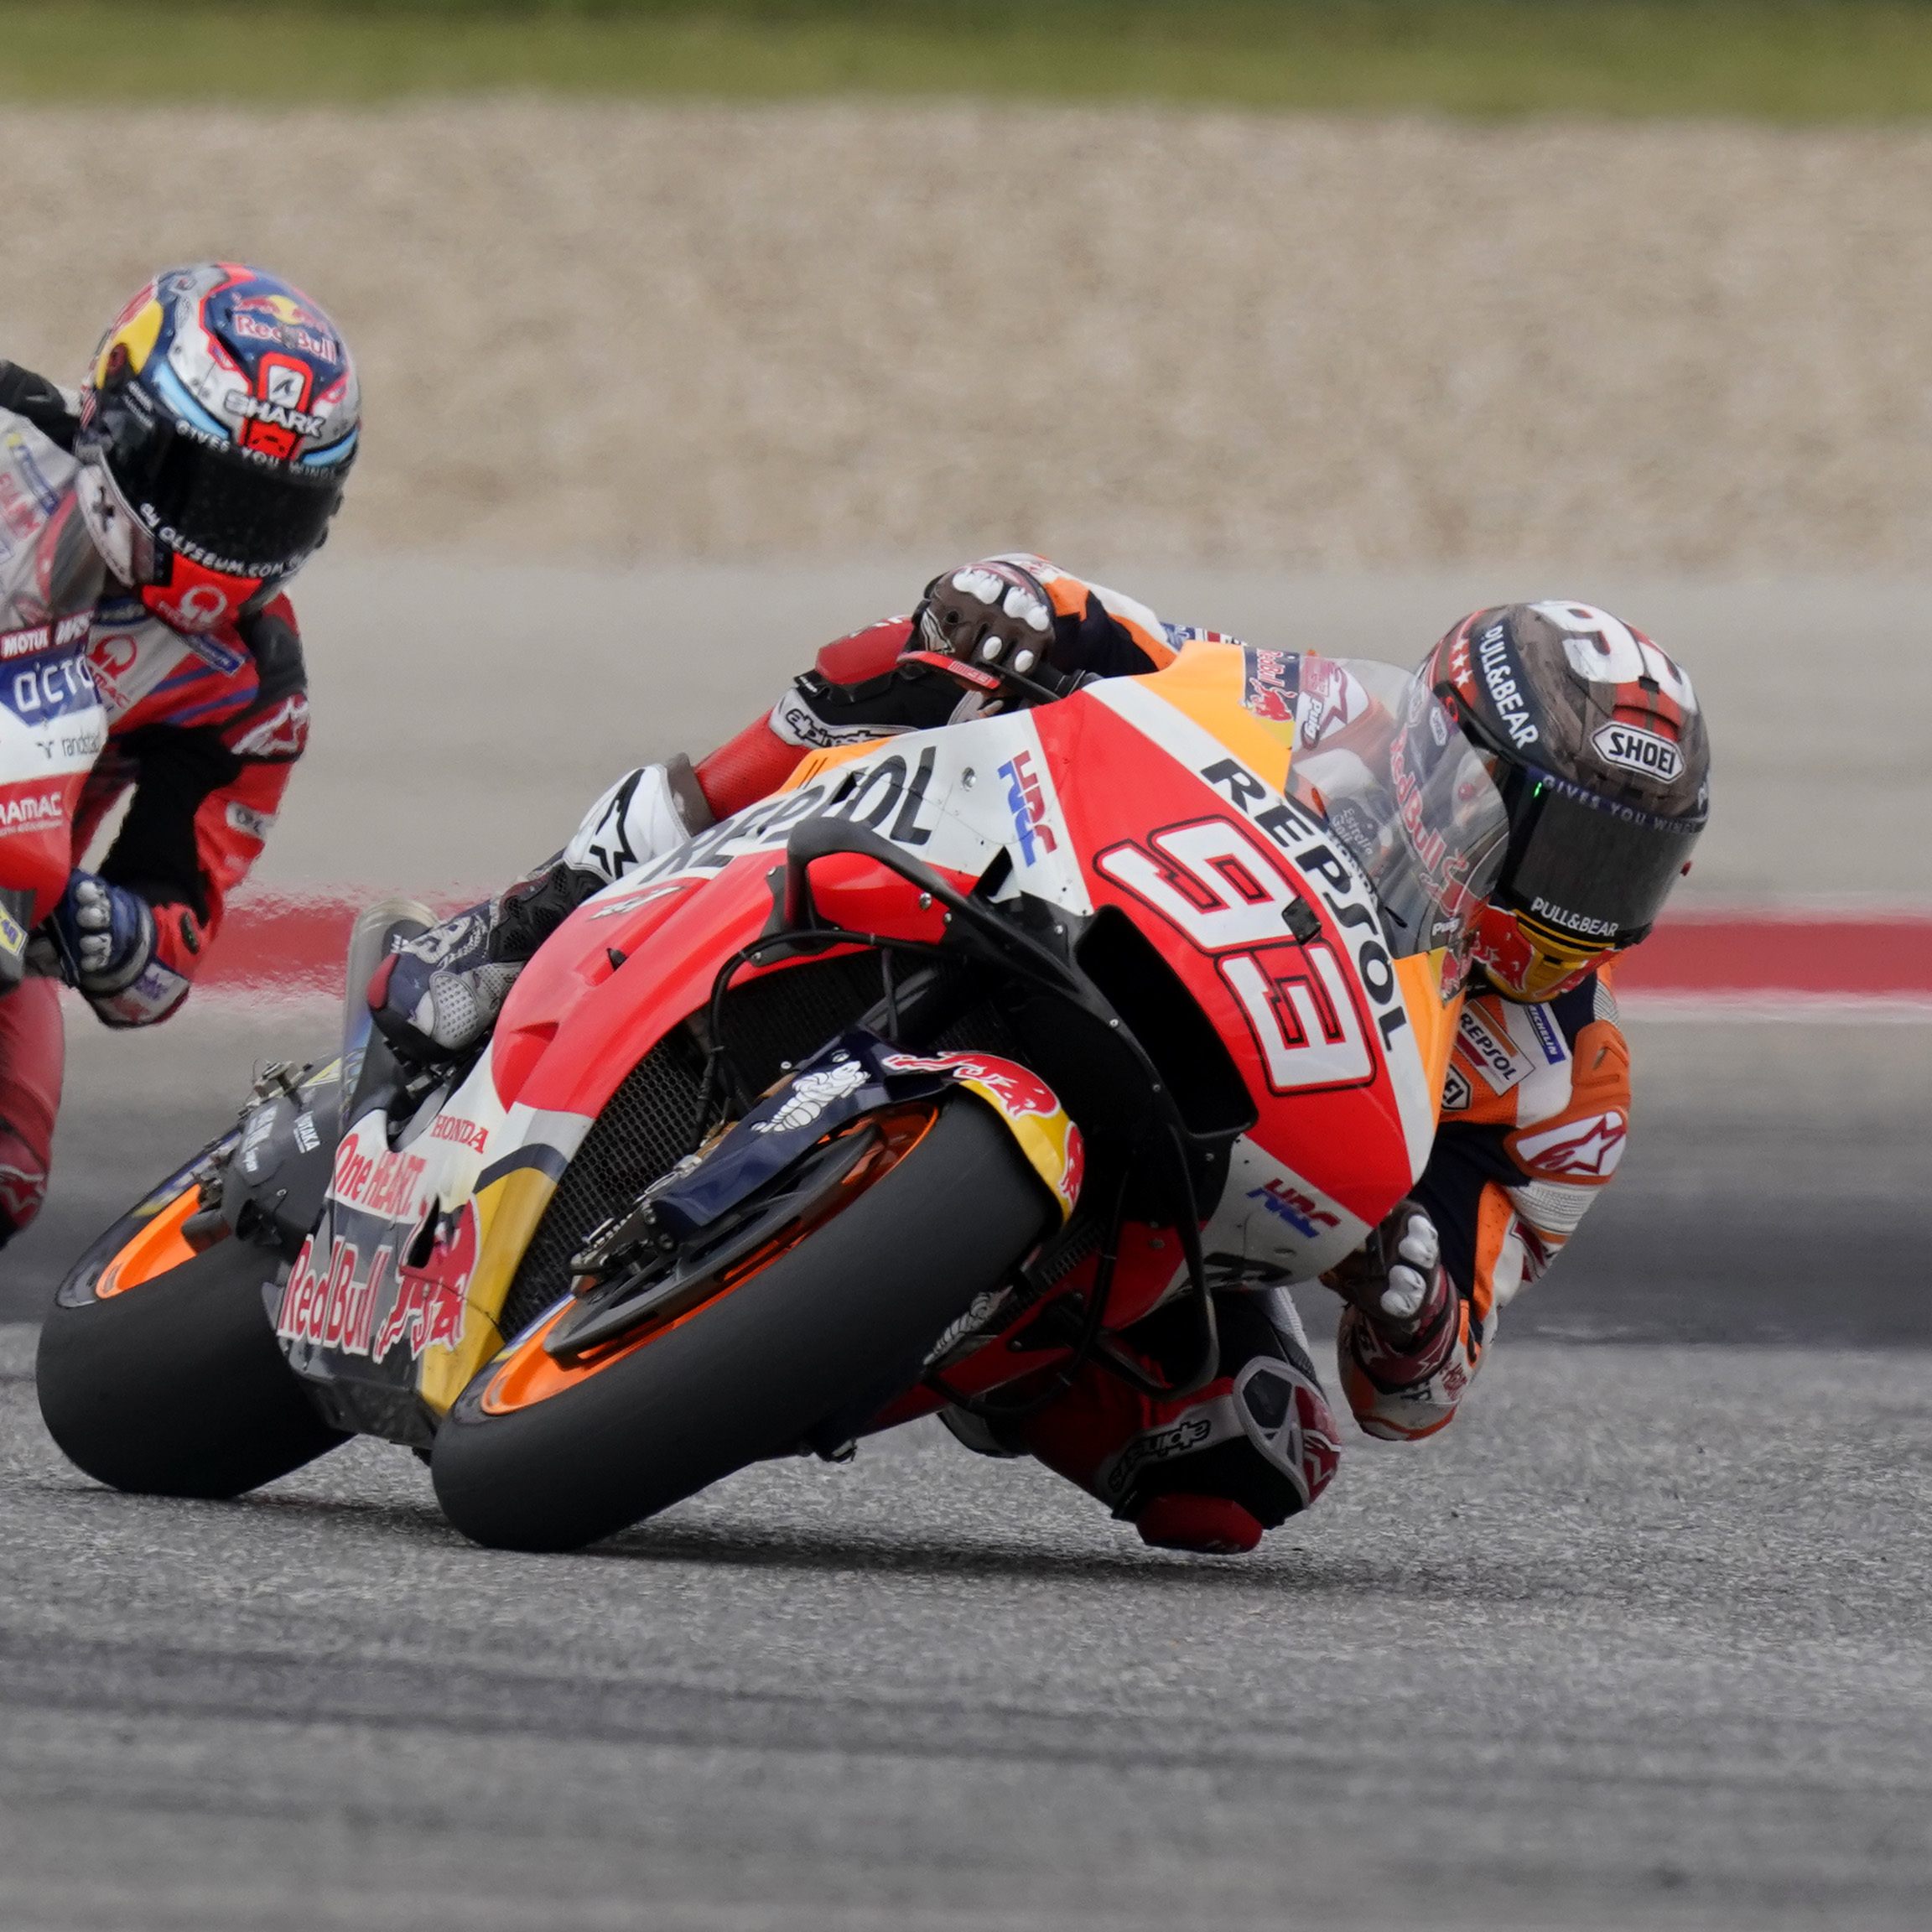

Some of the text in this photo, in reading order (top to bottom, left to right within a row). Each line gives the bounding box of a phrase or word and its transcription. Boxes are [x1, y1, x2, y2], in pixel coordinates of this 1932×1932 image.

[297, 330, 335, 364] Bull
[224, 389, 326, 439] SHARK
[1479, 625, 1540, 749] PULL&BEAR
[1608, 731, 1676, 774] SHOEI
[998, 750, 1057, 867] HRC
[1200, 758, 1406, 1052] REPSOL
[1531, 896, 1619, 937] PULL&BEAR
[1093, 815, 1377, 1096] 93
[1461, 1012, 1519, 1081] REPSOL
[430, 1114, 490, 1154] HONDA
[335, 1133, 373, 1200] One
[1247, 1178, 1341, 1239] HRC
